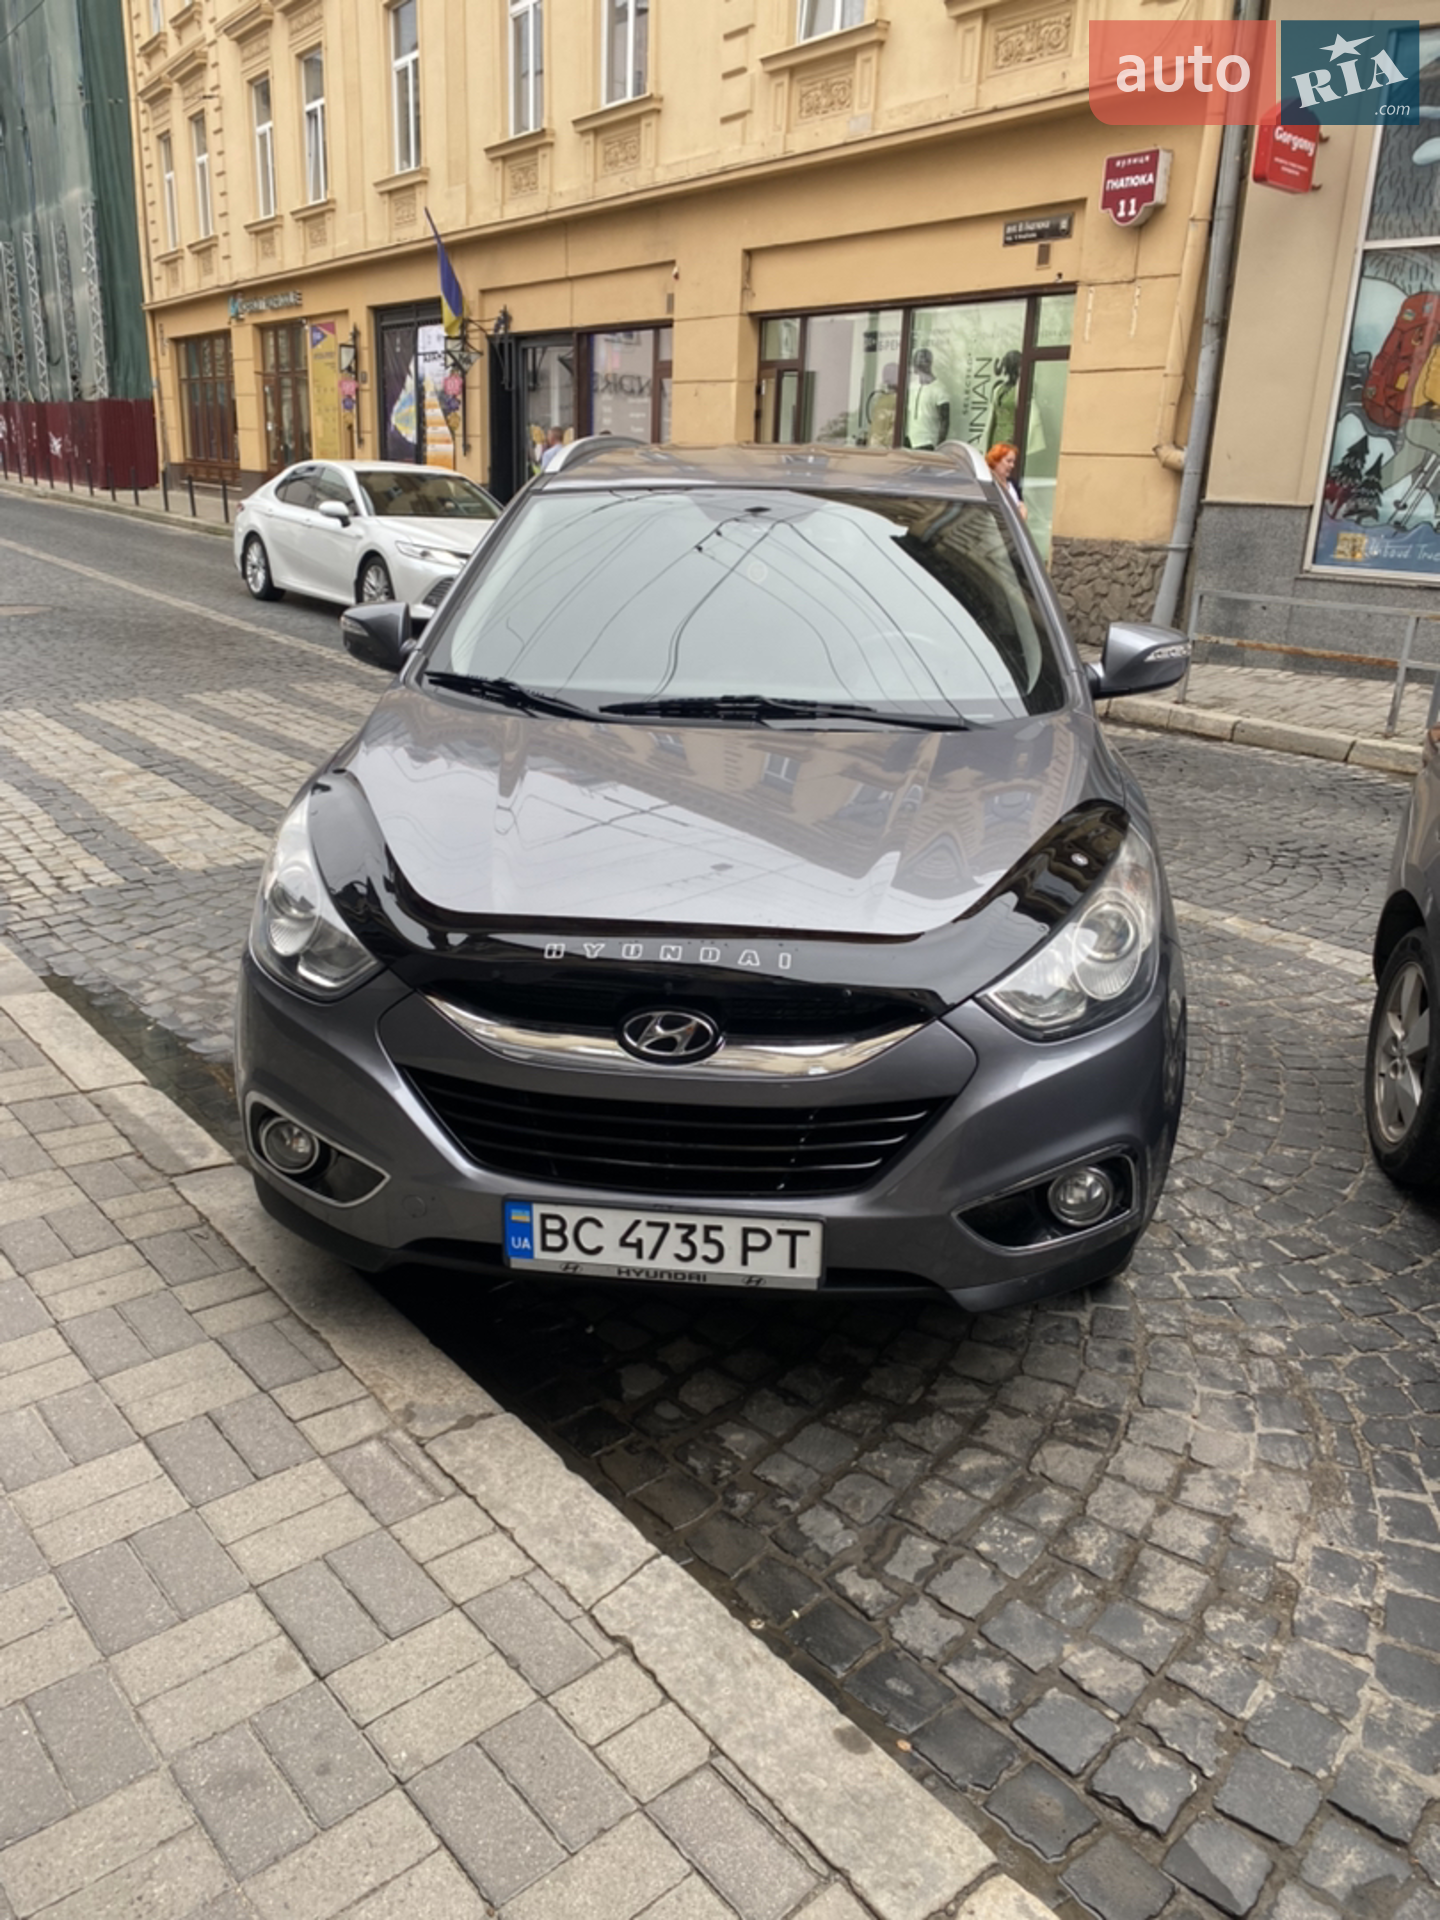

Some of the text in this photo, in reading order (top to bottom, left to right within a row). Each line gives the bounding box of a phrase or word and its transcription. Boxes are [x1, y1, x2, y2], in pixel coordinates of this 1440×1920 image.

[1274, 125, 1316, 157] Gorgany
[1105, 172, 1155, 191] ГНАТЮКА
[1116, 197, 1137, 218] 11
[544, 942, 792, 970] HYUNDAI
[511, 1236, 532, 1251] UA
[539, 1212, 811, 1269] BC 4735 PT
[616, 1267, 707, 1284] HYUNDAI
